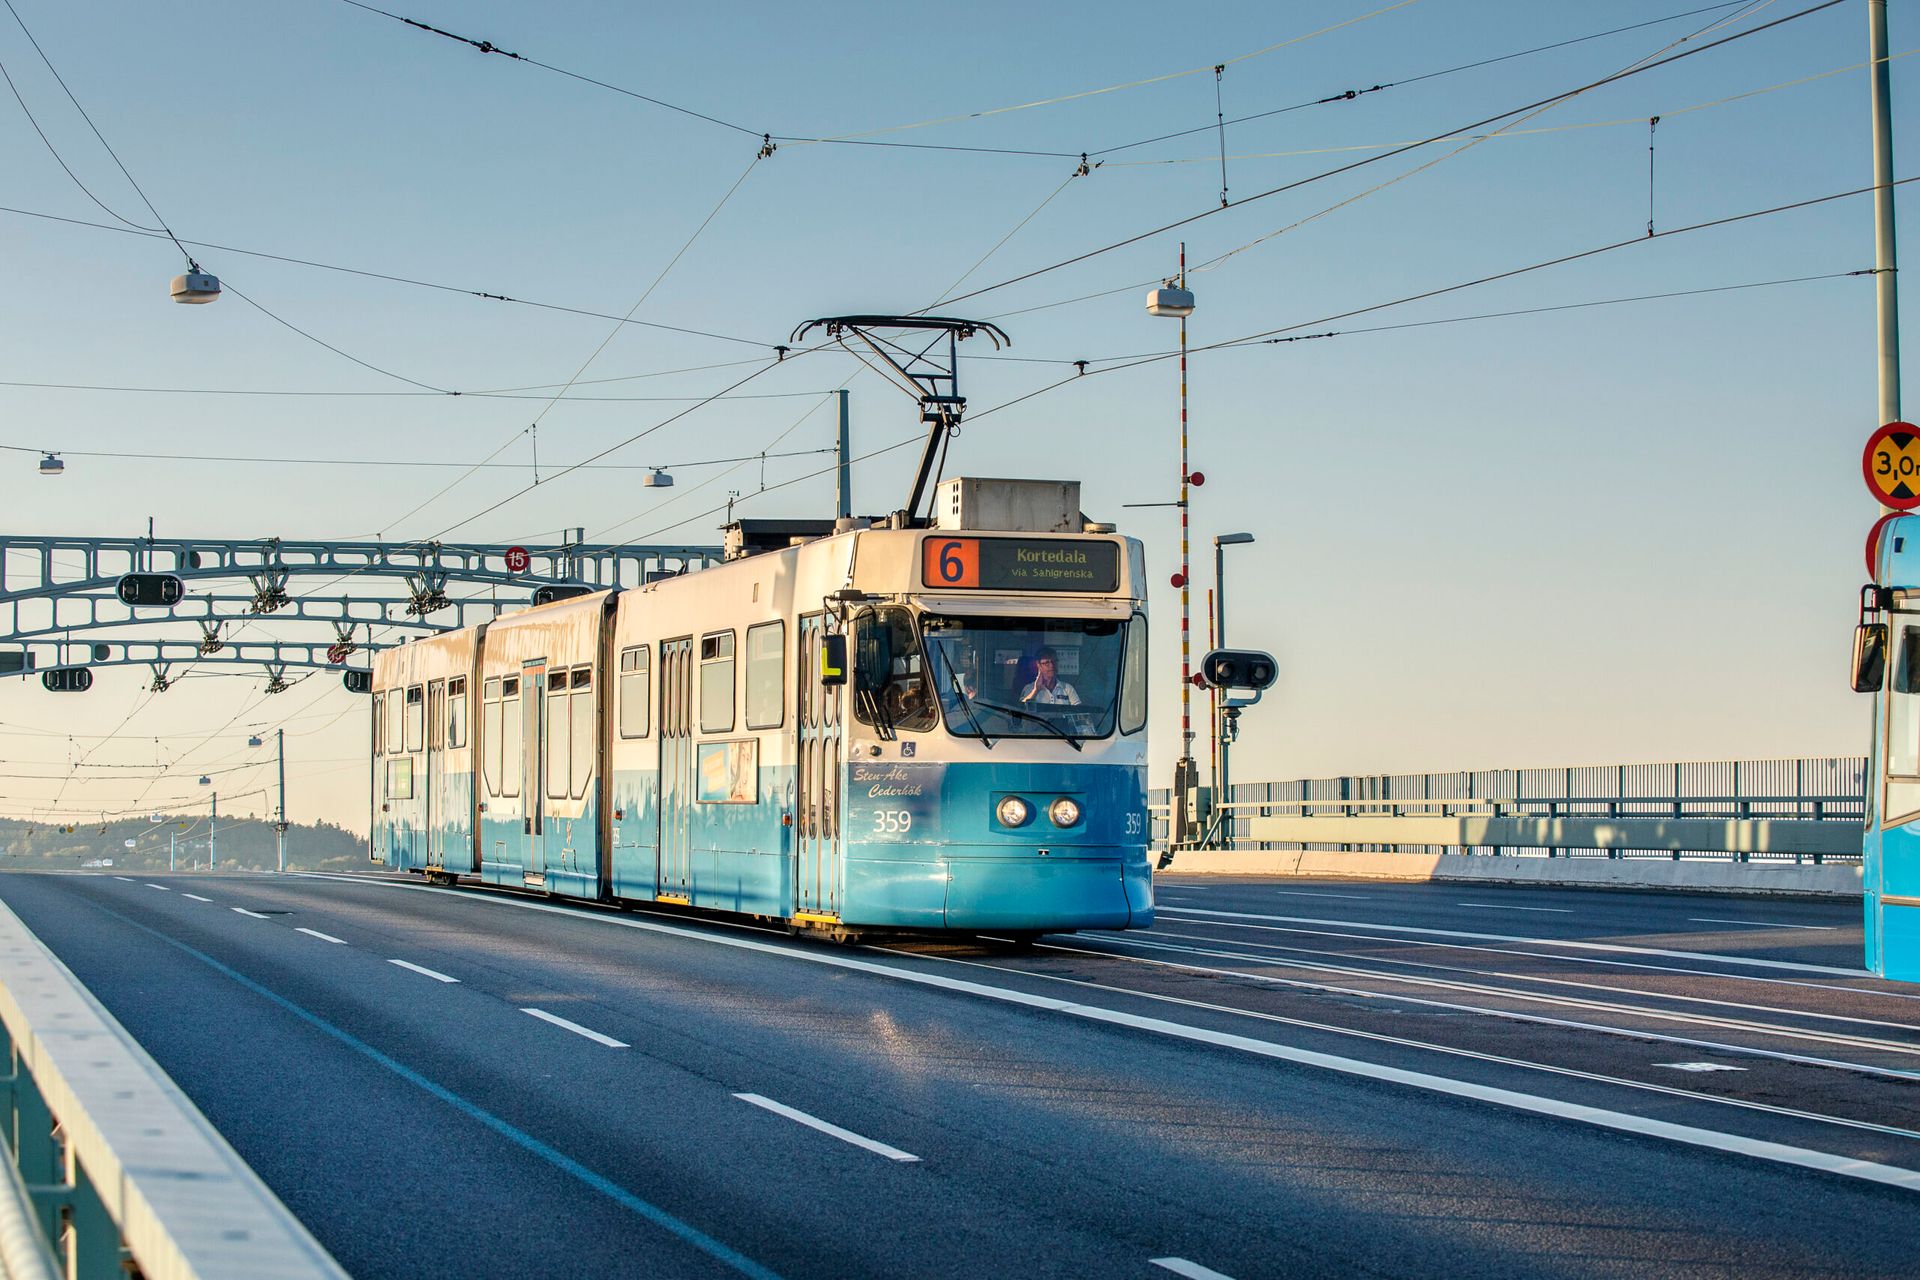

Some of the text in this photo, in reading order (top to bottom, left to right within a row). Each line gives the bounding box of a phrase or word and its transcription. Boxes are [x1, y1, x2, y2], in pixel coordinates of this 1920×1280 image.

[508, 551, 525, 567] 15
[939, 541, 964, 583] 6
[1016, 547, 1087, 564] Kortedala
[1011, 568, 1094, 580] via Sahlgrenska
[853, 764, 908, 781] Sten-Åke
[868, 783, 922, 798] Cederhök
[873, 810, 912, 833] 359
[1125, 812, 1142, 835] 359
